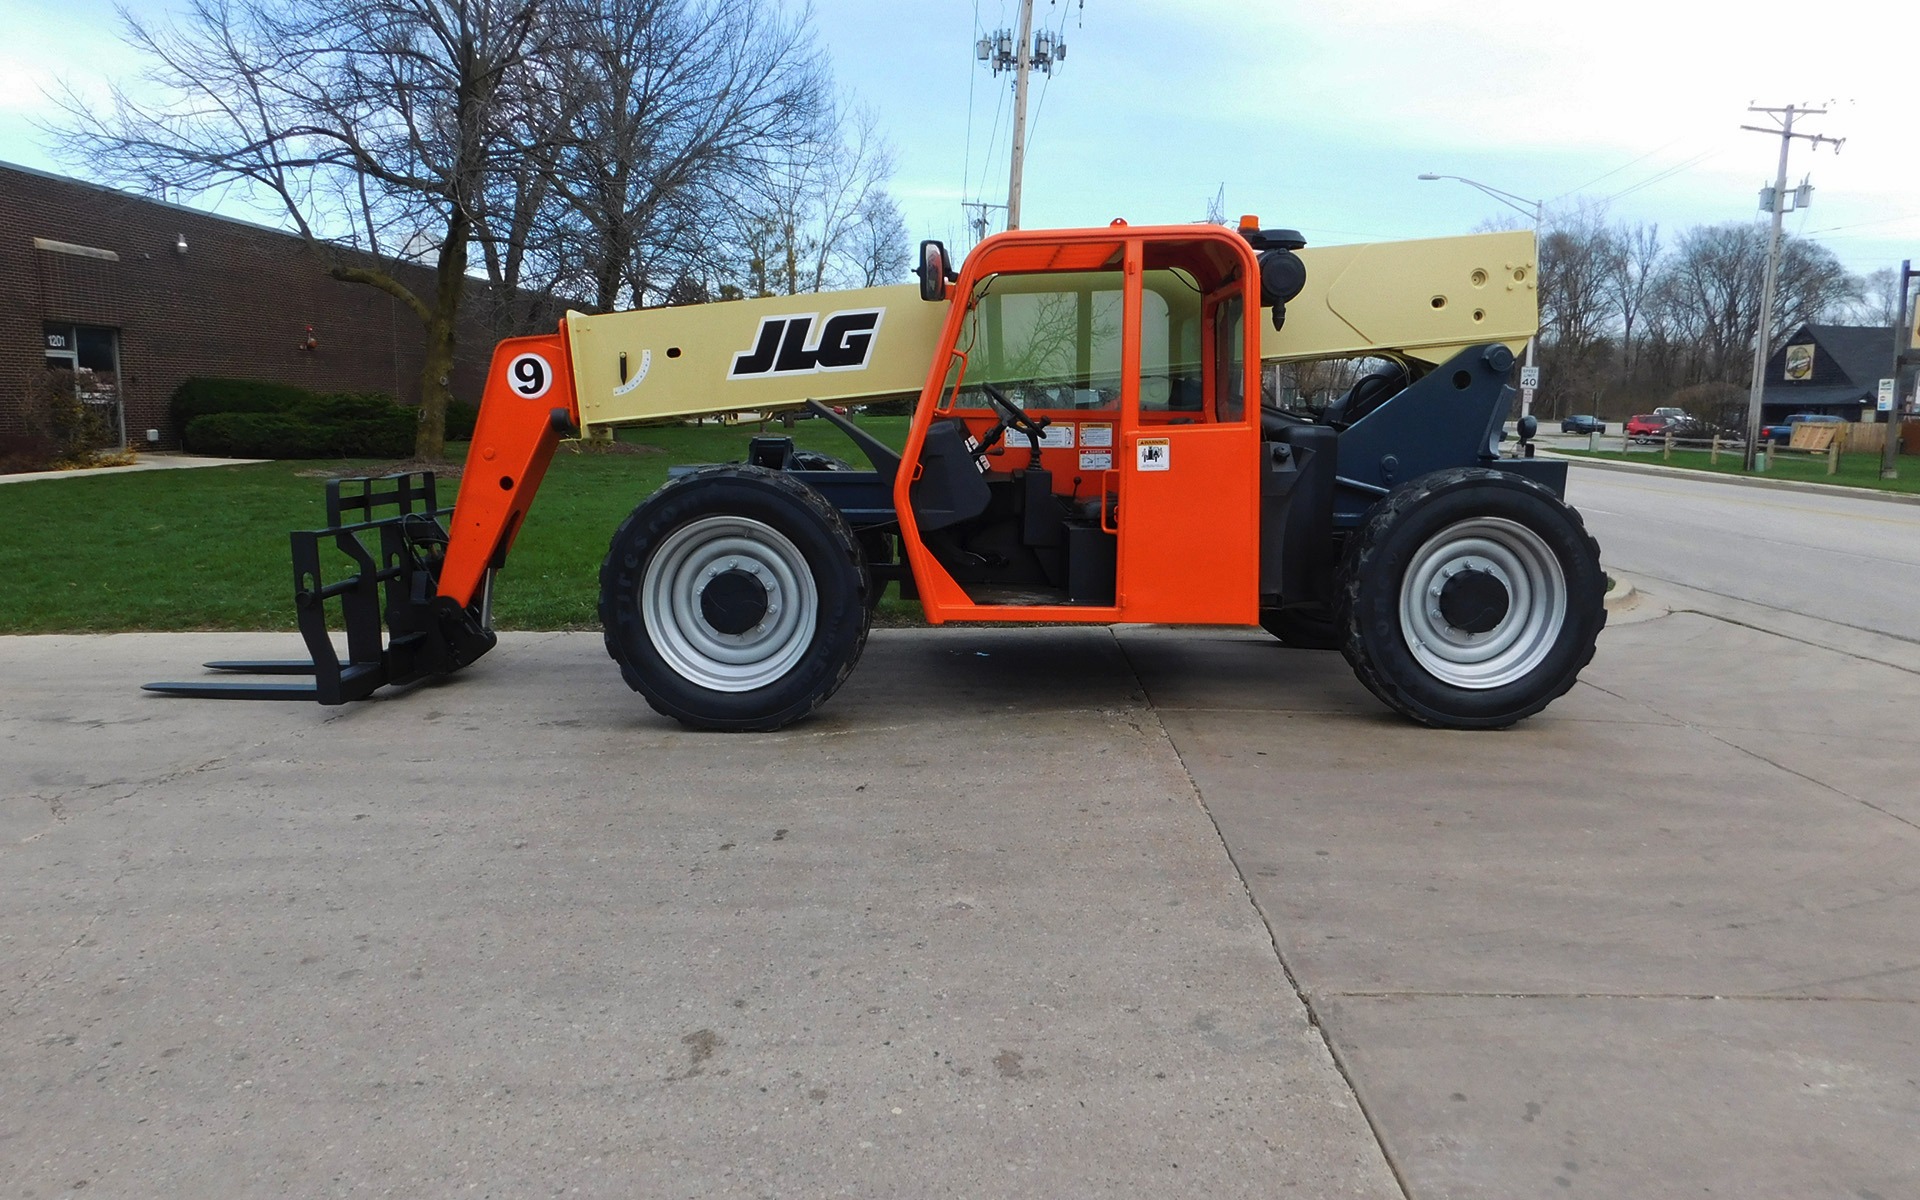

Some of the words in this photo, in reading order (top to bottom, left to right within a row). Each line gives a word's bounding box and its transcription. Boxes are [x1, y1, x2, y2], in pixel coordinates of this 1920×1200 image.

[48, 335, 65, 346] 1201
[730, 311, 882, 377] JLG
[514, 357, 545, 394] 9
[1522, 378, 1536, 386] 40
